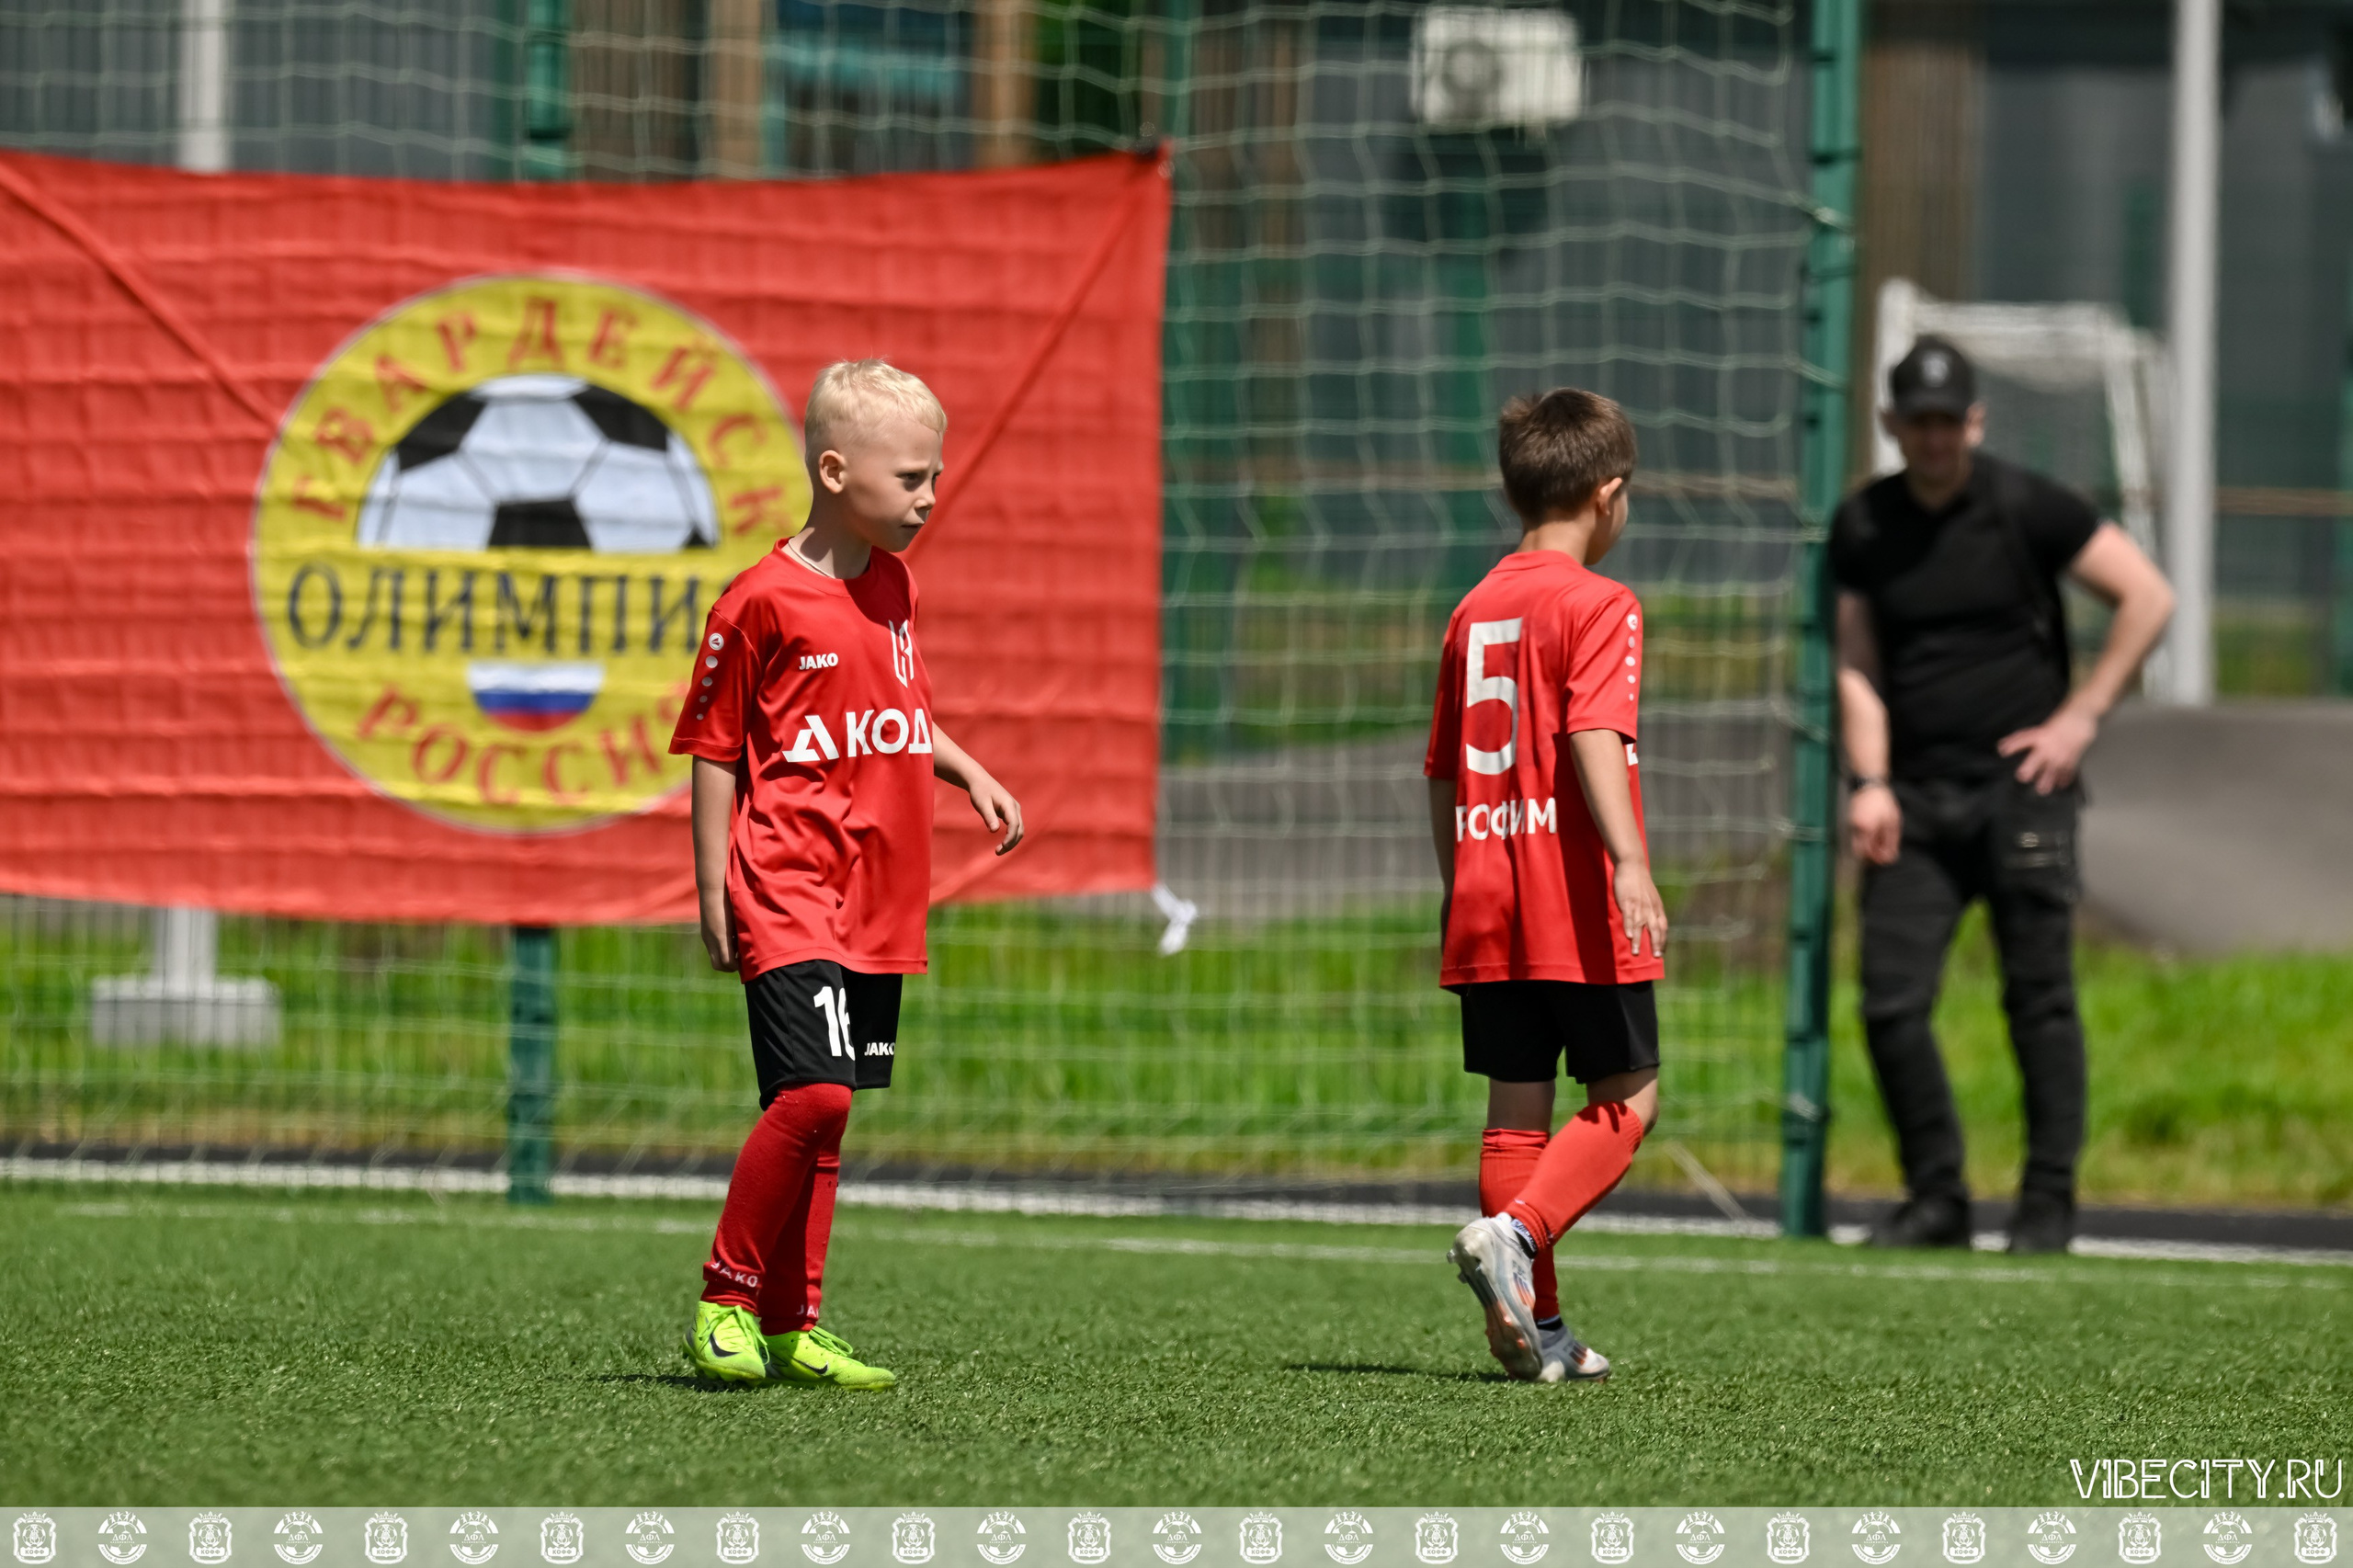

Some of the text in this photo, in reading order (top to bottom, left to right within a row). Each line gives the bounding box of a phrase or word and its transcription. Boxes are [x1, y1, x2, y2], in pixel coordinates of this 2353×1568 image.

[291, 294, 796, 539] ГВАРДЕЙСК
[288, 562, 732, 655] ОЛИМПИ
[799, 653, 838, 670] JAKO
[1466, 617, 1523, 775] 5
[710, 1258, 758, 1288] JAKO
[796, 1304, 819, 1319] JA
